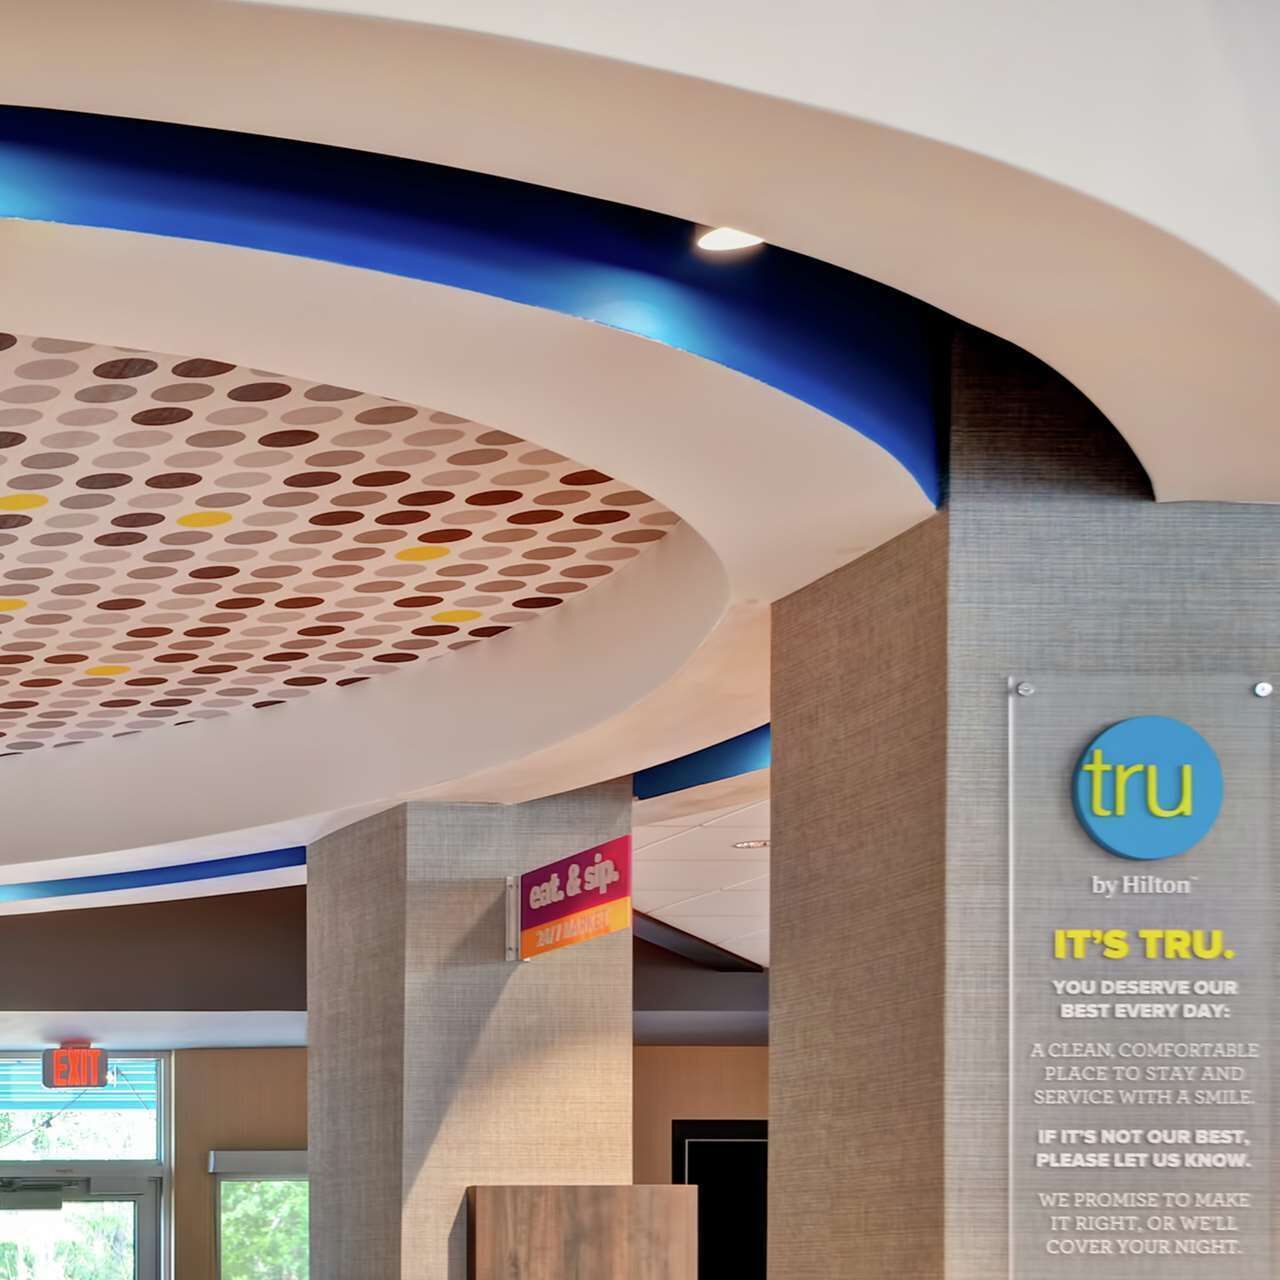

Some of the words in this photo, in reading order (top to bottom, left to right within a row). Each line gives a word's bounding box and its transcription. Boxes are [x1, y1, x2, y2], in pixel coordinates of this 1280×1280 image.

[1081, 748, 1194, 819] tru
[566, 863, 582, 896] &
[1092, 875, 1118, 898] by
[1052, 928, 1129, 960] IT'S
[1138, 928, 1236, 960] TRU.
[1052, 979, 1096, 995] YOU
[1100, 979, 1190, 995] DESERVE
[1193, 979, 1239, 995] OUR
[1060, 1003, 1112, 1019] BEST
[1114, 1003, 1179, 1019] EVERY
[1182, 1003, 1232, 1019] DAY:
[1030, 1043, 1046, 1058] A
[1119, 1043, 1261, 1058] COMFORTABLE
[53, 1048, 103, 1087] EXIT
[1044, 1066, 1108, 1081] PLACE
[1112, 1066, 1140, 1081] TO
[1145, 1066, 1198, 1081] STAY
[1201, 1066, 1246, 1081] AND
[1034, 1089, 1114, 1105] SERVICE
[1118, 1089, 1173, 1105] WITH
[1175, 1089, 1191, 1105] A
[1194, 1089, 1256, 1105] SMILE.
[1037, 1129, 1057, 1144] IF
[1060, 1129, 1097, 1144] IT'S
[1100, 1129, 1144, 1144] NOT
[1146, 1129, 1190, 1144] OUR
[1195, 1129, 1252, 1146] BEST,
[1036, 1152, 1110, 1168] PLEASE
[1113, 1152, 1149, 1168] LET
[1152, 1152, 1182, 1168] US
[1184, 1152, 1253, 1168] KNOW.
[1038, 1192, 1070, 1208] WE
[1073, 1192, 1159, 1208] PROMISE
[1163, 1192, 1190, 1208] TO
[1195, 1192, 1252, 1208] MAKE
[1050, 1216, 1072, 1231] IT
[1075, 1216, 1143, 1233] RIGHT,
[1146, 1216, 1176, 1231] OR
[1179, 1216, 1239, 1231] WE'LL
[1045, 1239, 1113, 1255] COVER
[1115, 1239, 1171, 1255] YOUR
[1175, 1239, 1242, 1255] NIGHT.
